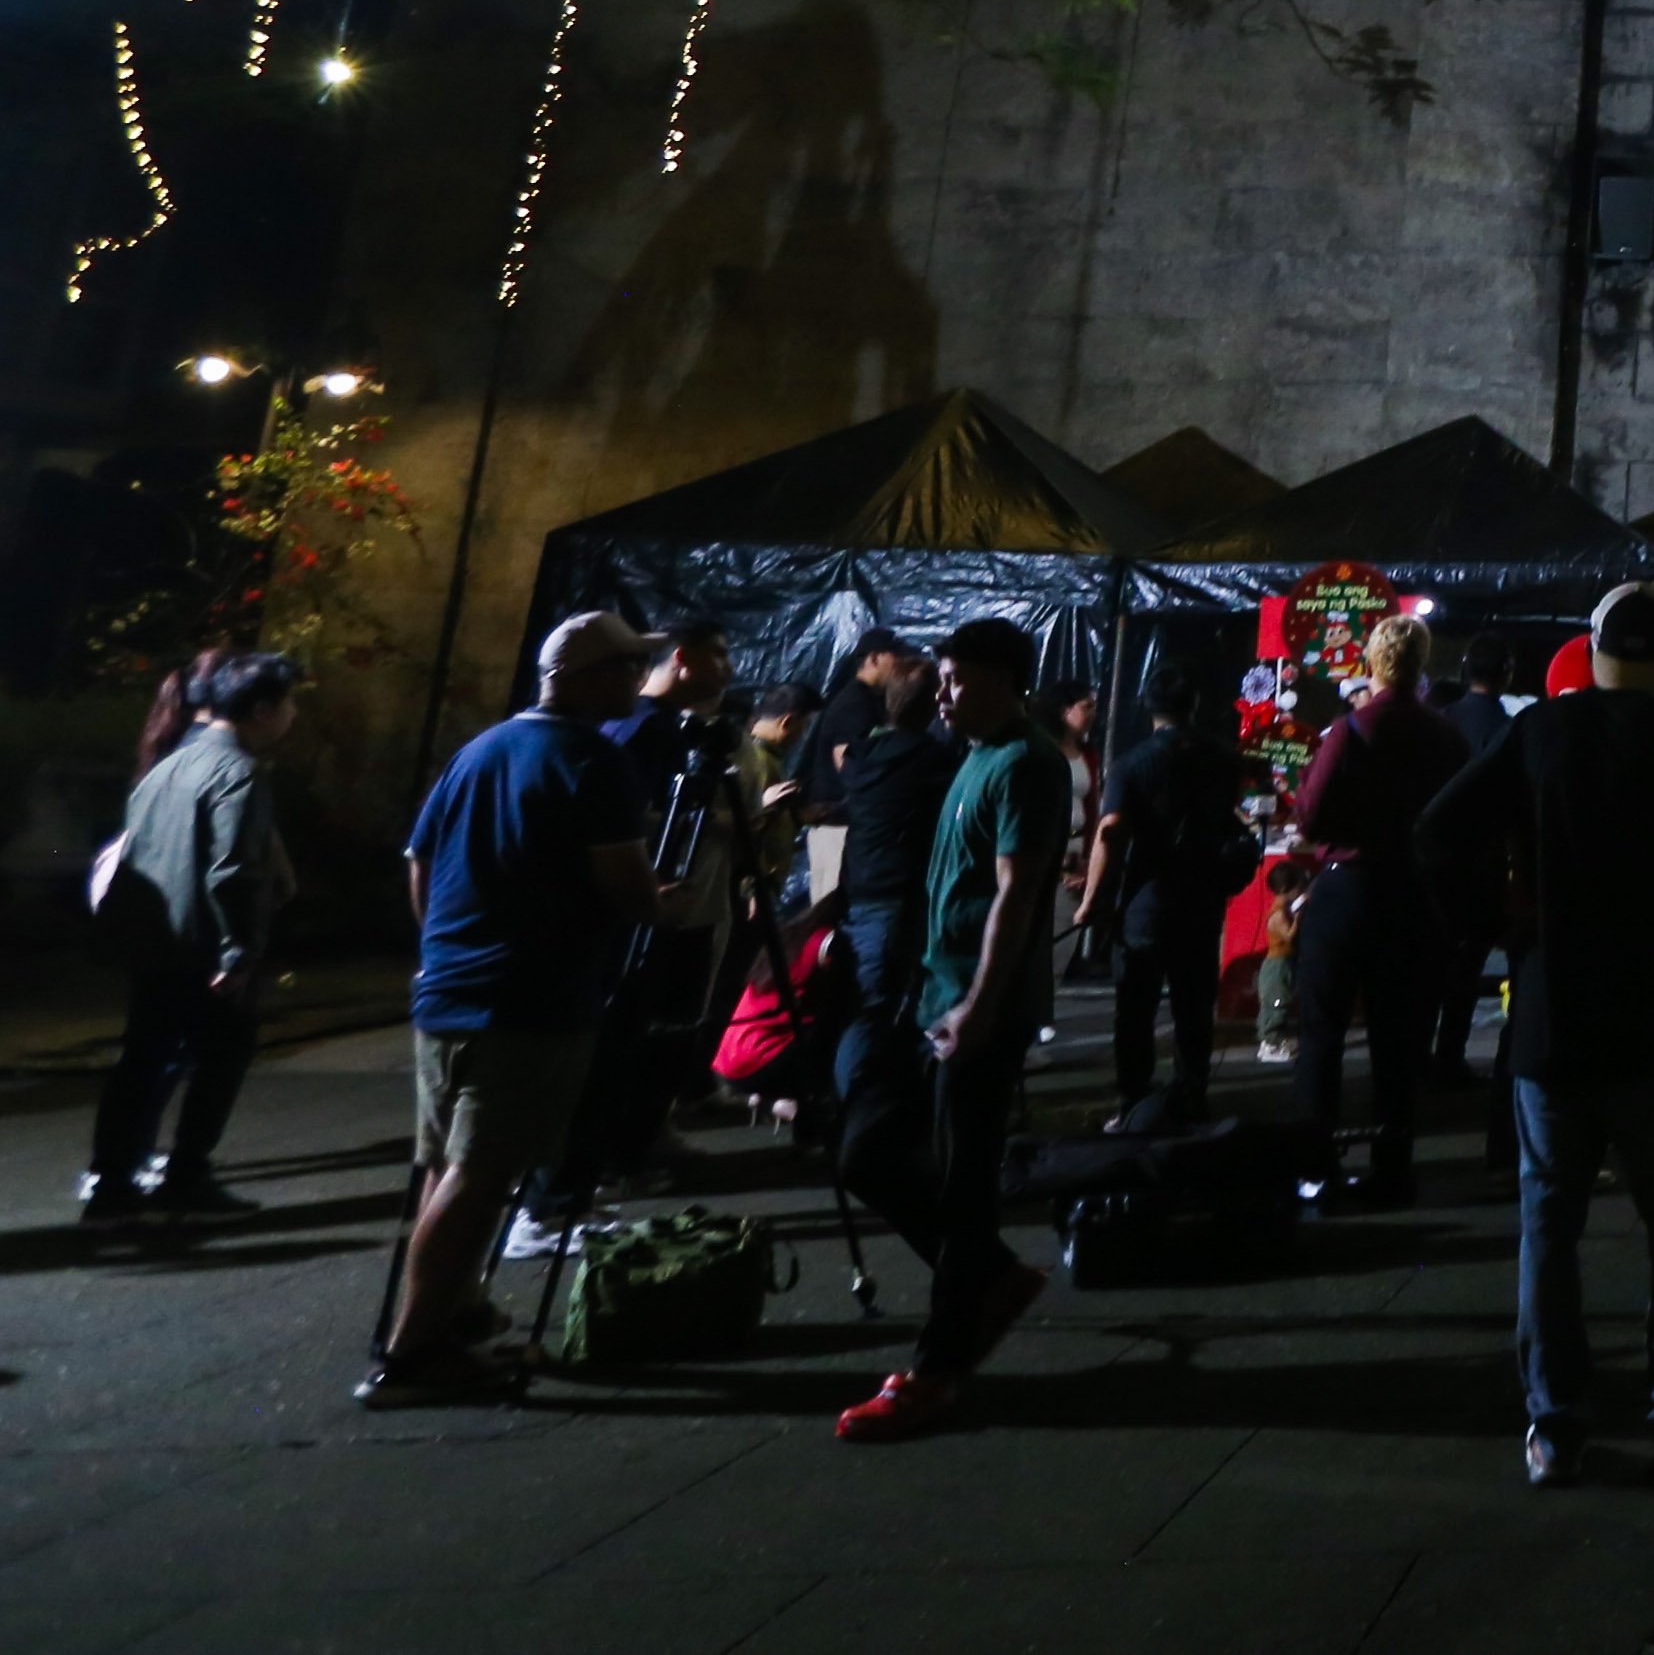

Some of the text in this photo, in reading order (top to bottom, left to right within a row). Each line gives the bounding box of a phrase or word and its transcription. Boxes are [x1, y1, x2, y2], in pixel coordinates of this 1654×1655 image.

[1316, 583, 1369, 599] Buo ang
[1296, 596, 1387, 613] saya ng Pasko
